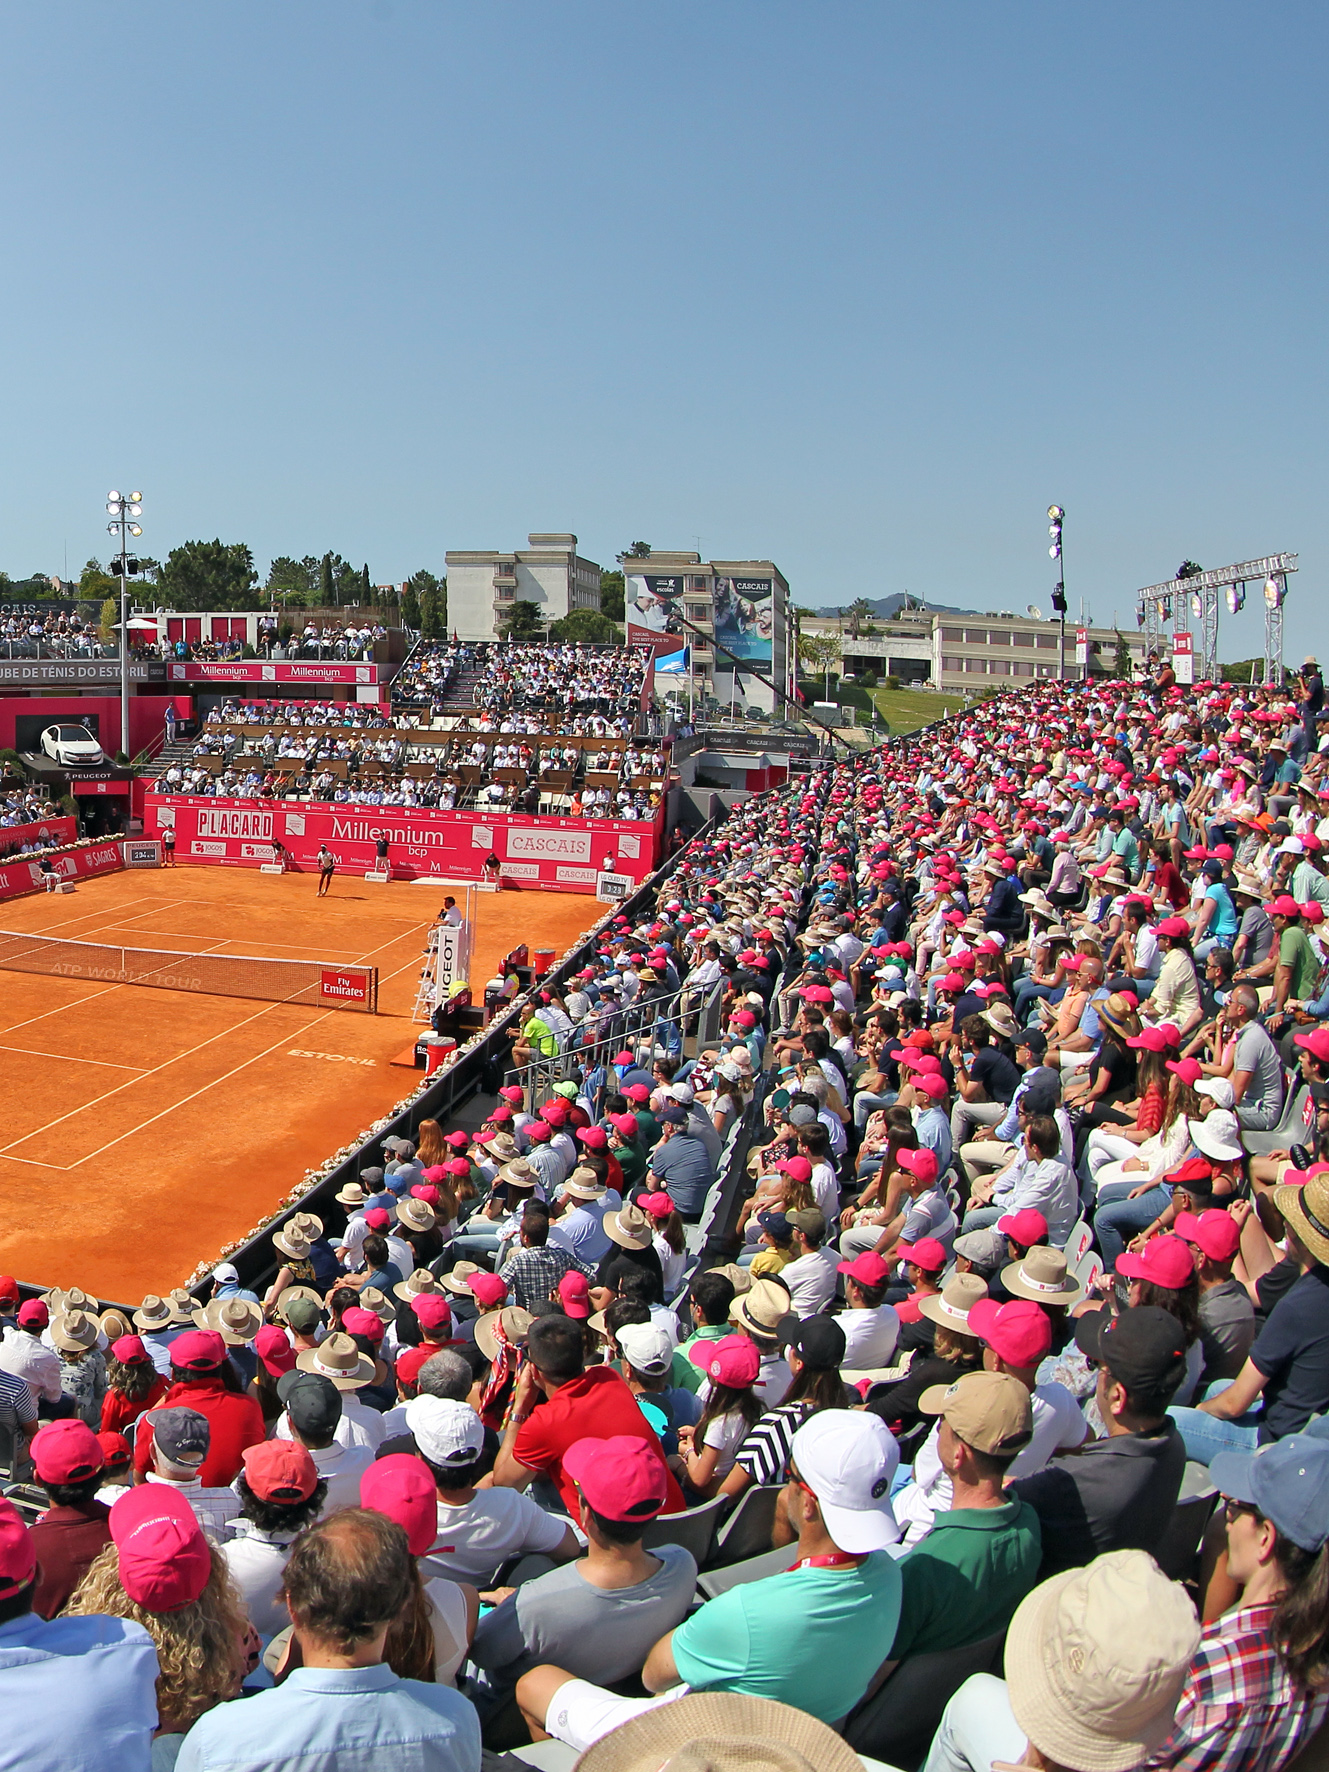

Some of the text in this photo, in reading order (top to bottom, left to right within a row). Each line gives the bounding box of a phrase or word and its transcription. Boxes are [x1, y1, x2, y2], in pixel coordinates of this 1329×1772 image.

[736, 582, 768, 590] CASCAIS
[22, 667, 39, 678] DE
[40, 665, 75, 678] TÉNIS
[77, 667, 96, 677] DO
[200, 665, 248, 675] Millennium
[290, 665, 340, 676] Millennium
[199, 812, 272, 836] PLACARD
[331, 816, 444, 845] Millennium
[408, 846, 428, 857] bcp
[512, 837, 586, 854] CASCAIS
[92, 847, 117, 867] SAGRES
[501, 866, 537, 875] CASCAIS
[559, 870, 595, 879] CASCAIS
[50, 962, 202, 989] ATP WORLD TOUR
[337, 977, 350, 987] Fly
[324, 982, 364, 998] Emirates
[287, 1049, 377, 1066] ESTORIL
